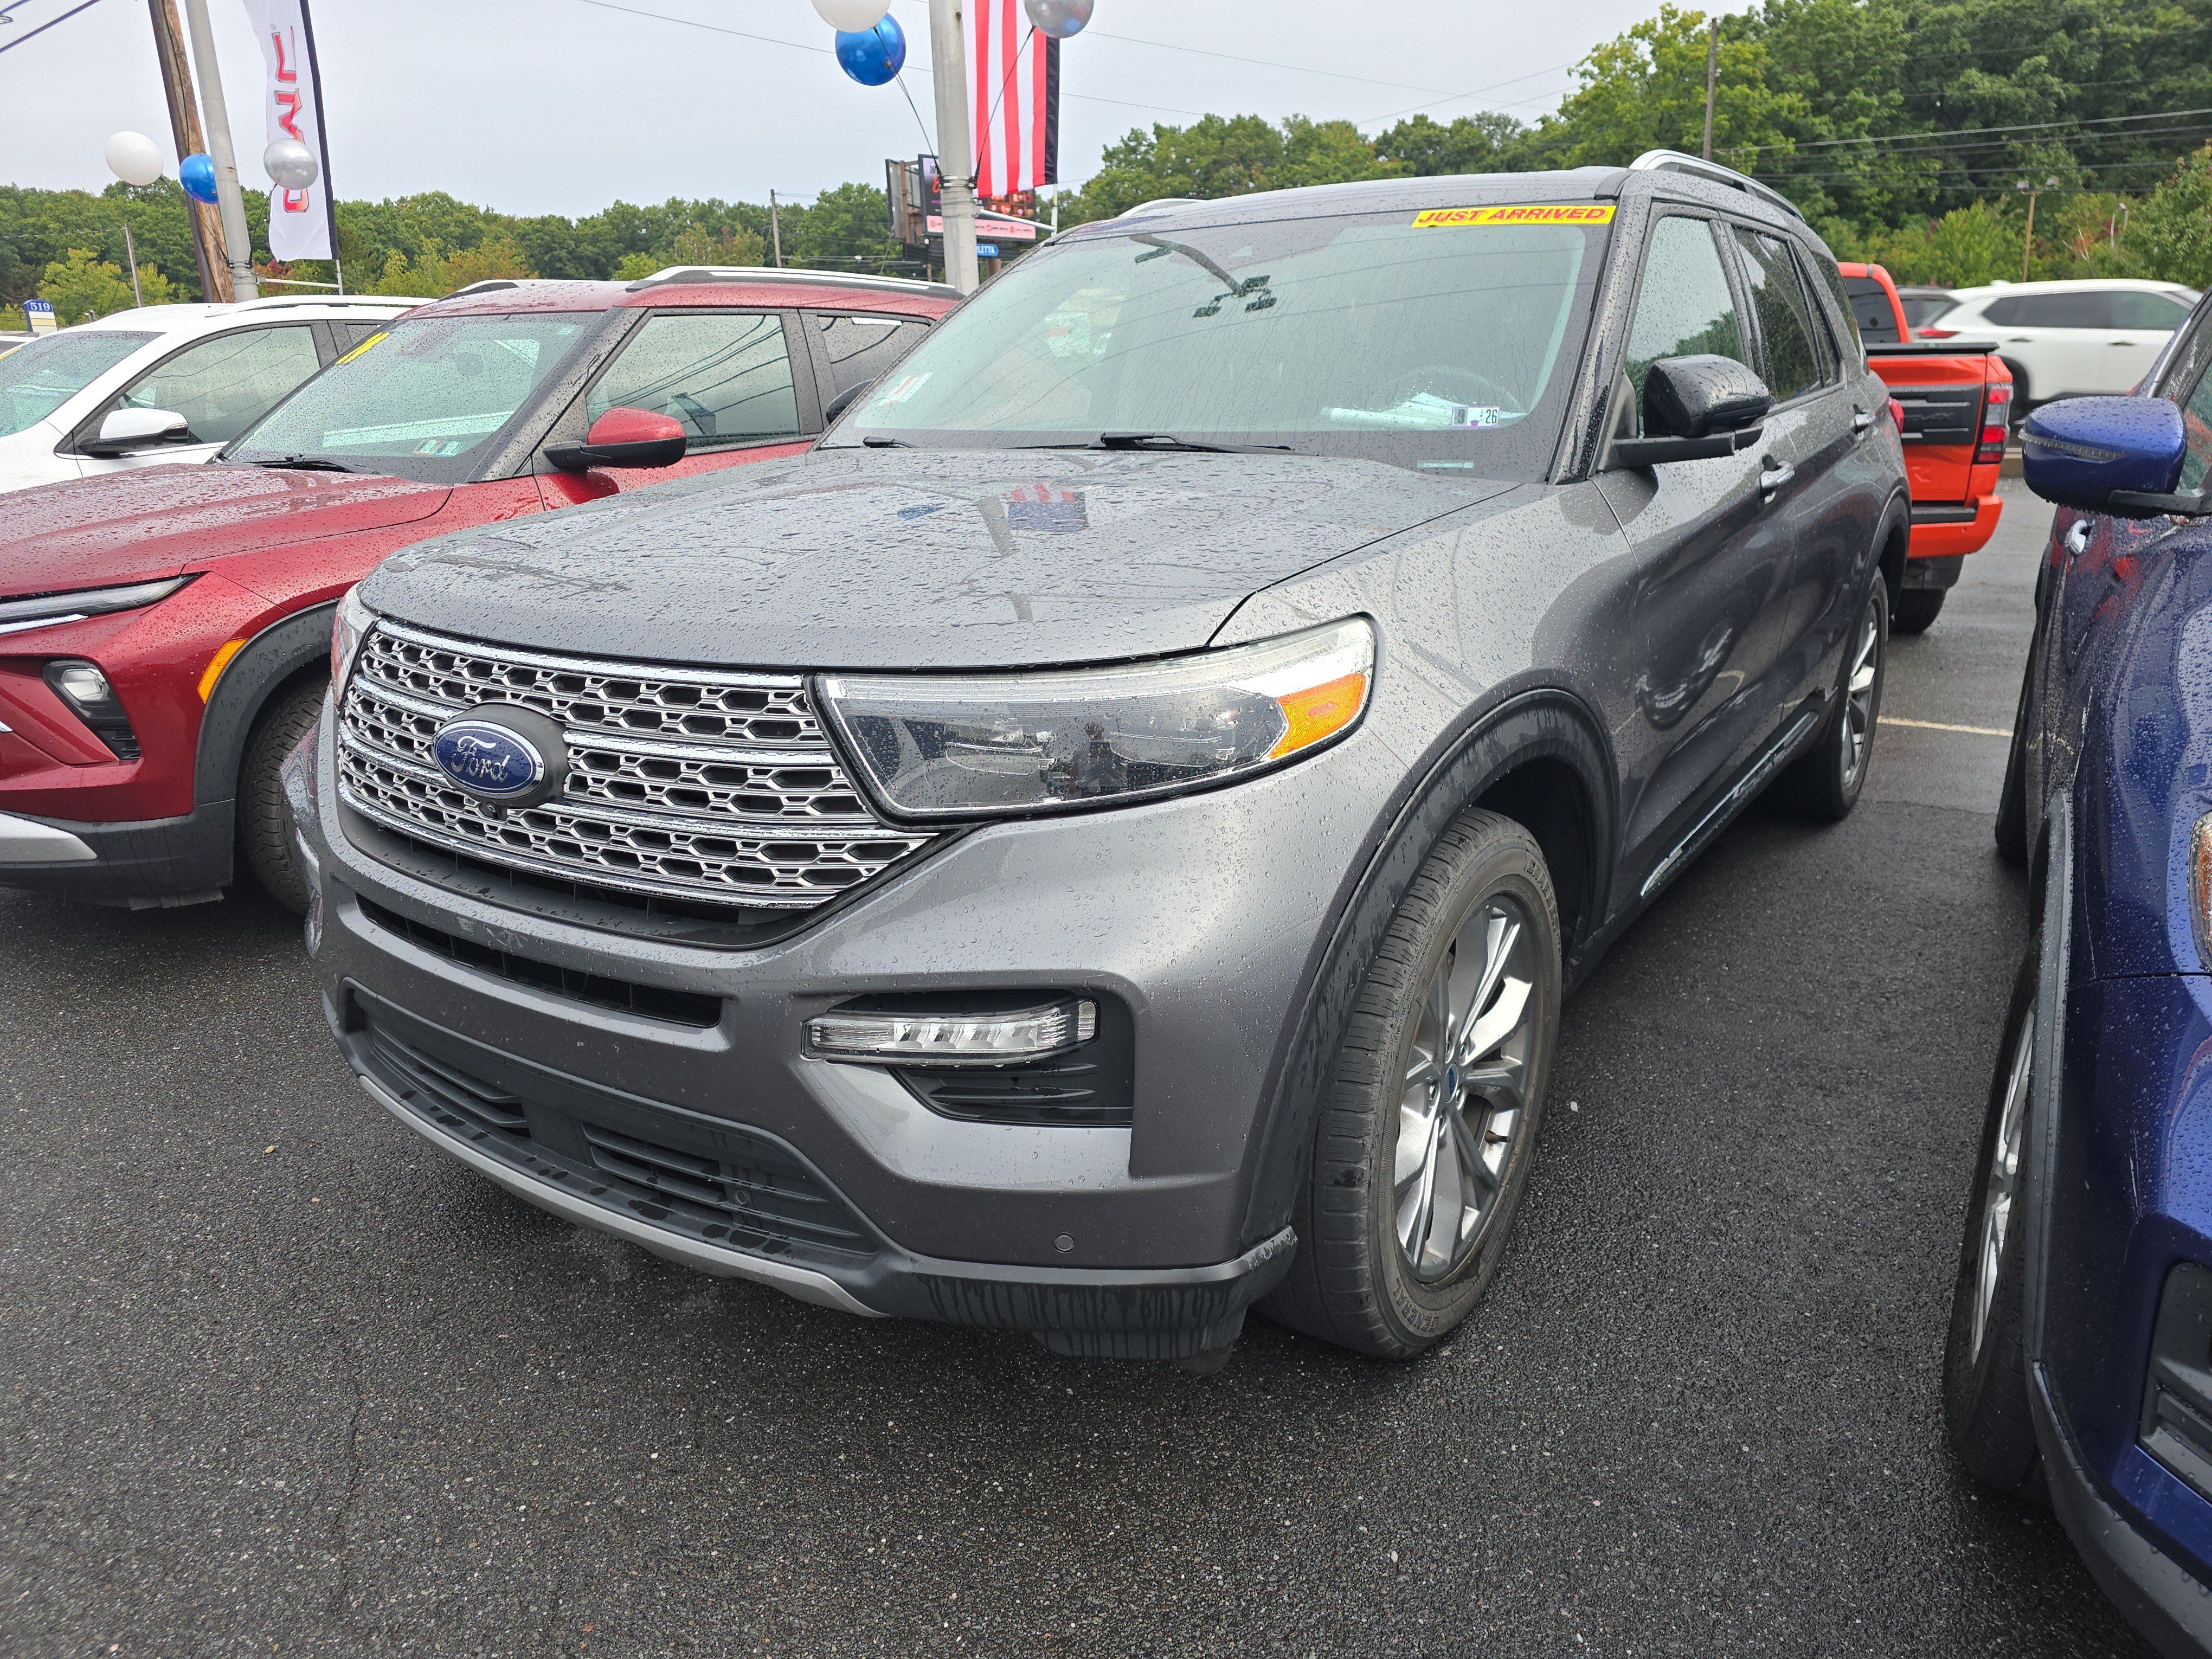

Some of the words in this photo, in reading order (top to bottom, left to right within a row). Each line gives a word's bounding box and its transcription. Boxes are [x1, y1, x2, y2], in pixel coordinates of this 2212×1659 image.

[1418, 210, 1488, 223] JUST
[1487, 208, 1609, 222] ARRIVED
[30, 302, 50, 311] 519
[1486, 409, 1497, 424] 26
[451, 735, 511, 782] Ford
[1393, 1277, 1440, 1332] GENERAL
